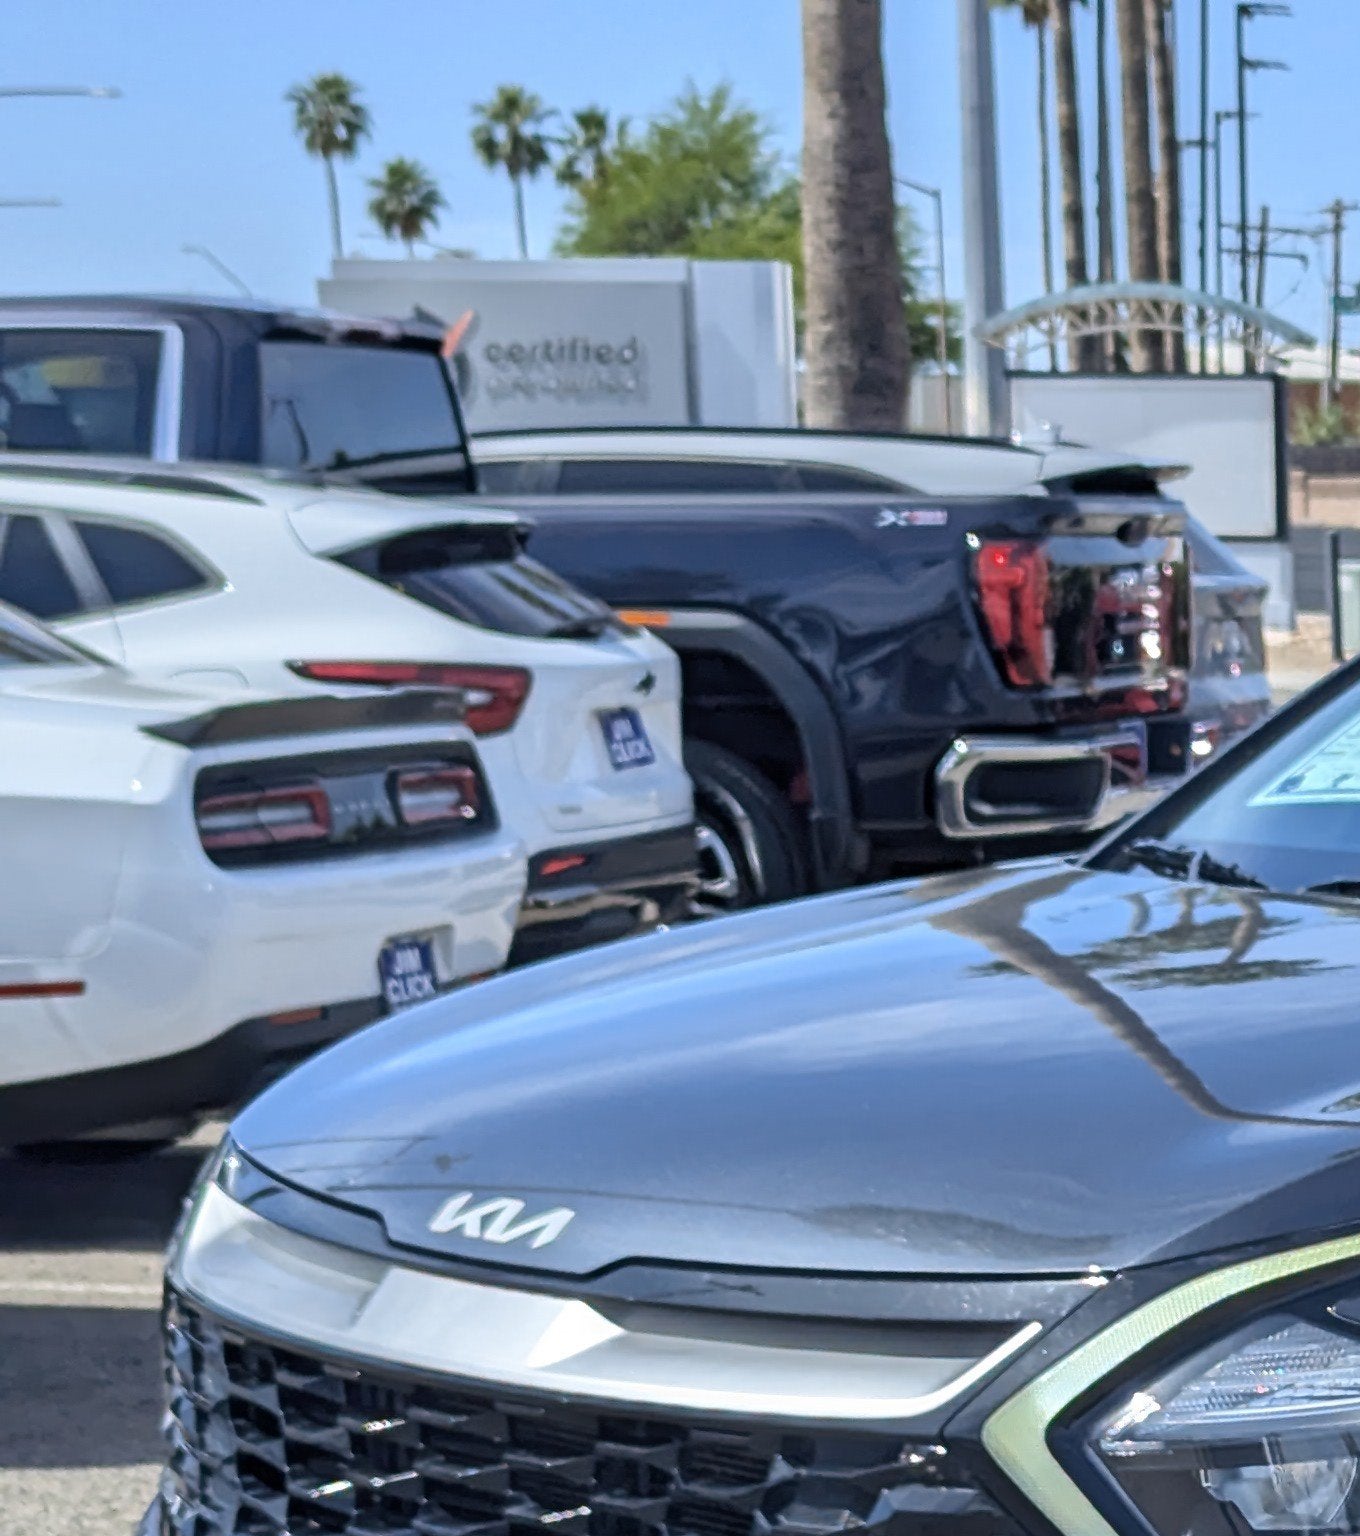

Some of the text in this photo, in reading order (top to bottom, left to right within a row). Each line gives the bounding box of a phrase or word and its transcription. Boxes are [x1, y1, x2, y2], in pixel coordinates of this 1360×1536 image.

[485, 336, 639, 364] certified
[393, 945, 423, 975] JIM
[428, 1190, 577, 1250] KIA
